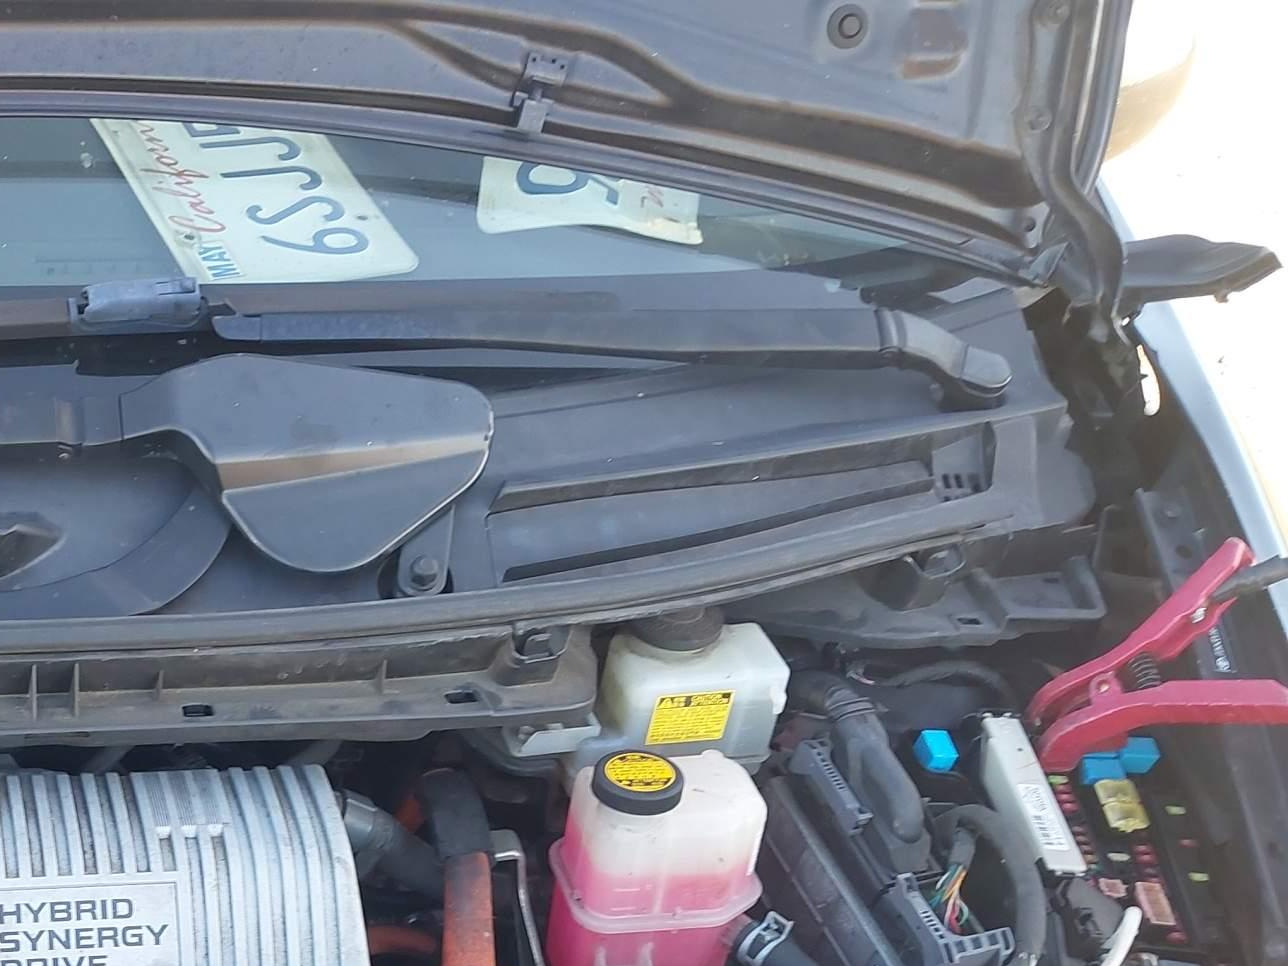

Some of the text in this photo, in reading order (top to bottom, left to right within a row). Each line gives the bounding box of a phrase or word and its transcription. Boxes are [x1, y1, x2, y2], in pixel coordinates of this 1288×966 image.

[136, 122, 226, 232] Californ
[198, 243, 240, 278] MAY
[0, 924, 169, 953] SYNERGY
